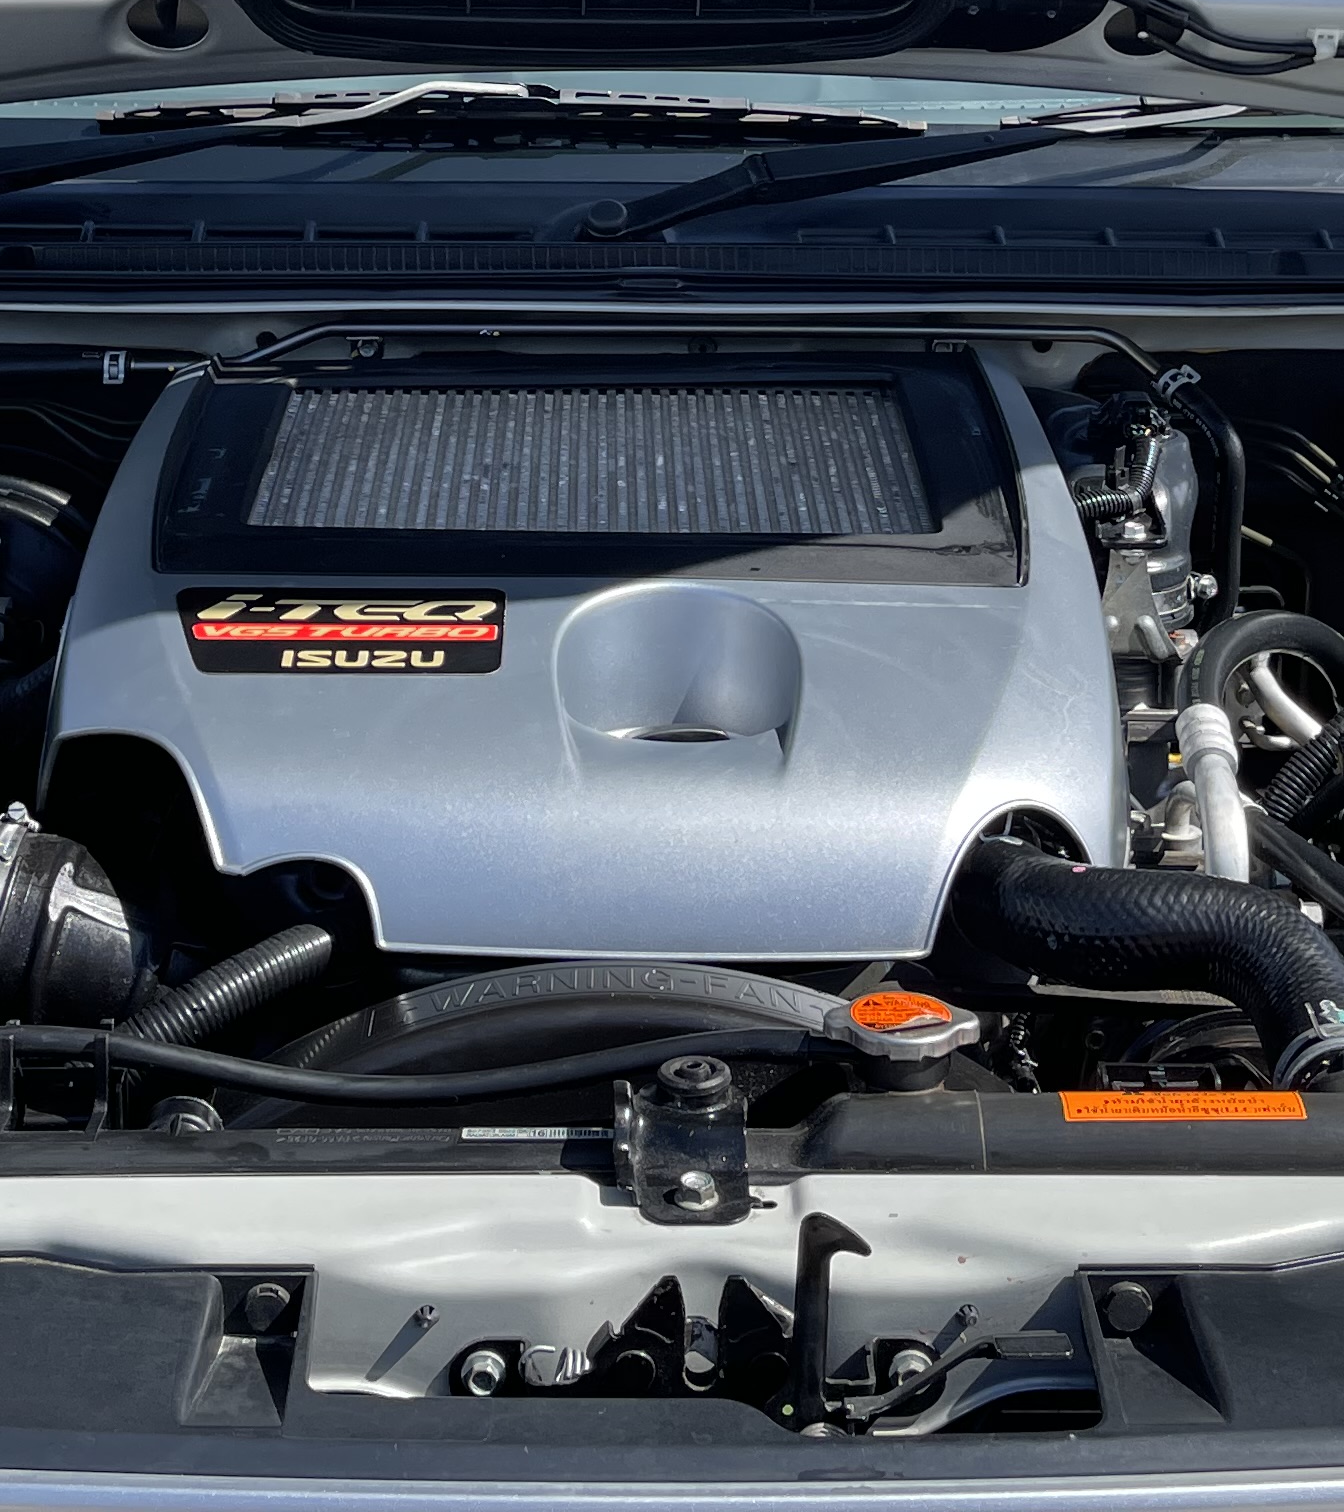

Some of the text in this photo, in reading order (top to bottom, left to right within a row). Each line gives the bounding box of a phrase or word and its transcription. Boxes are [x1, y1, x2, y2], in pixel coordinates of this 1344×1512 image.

[202, 625, 491, 639] VGS TURBO
[280, 649, 446, 668] ISUZU
